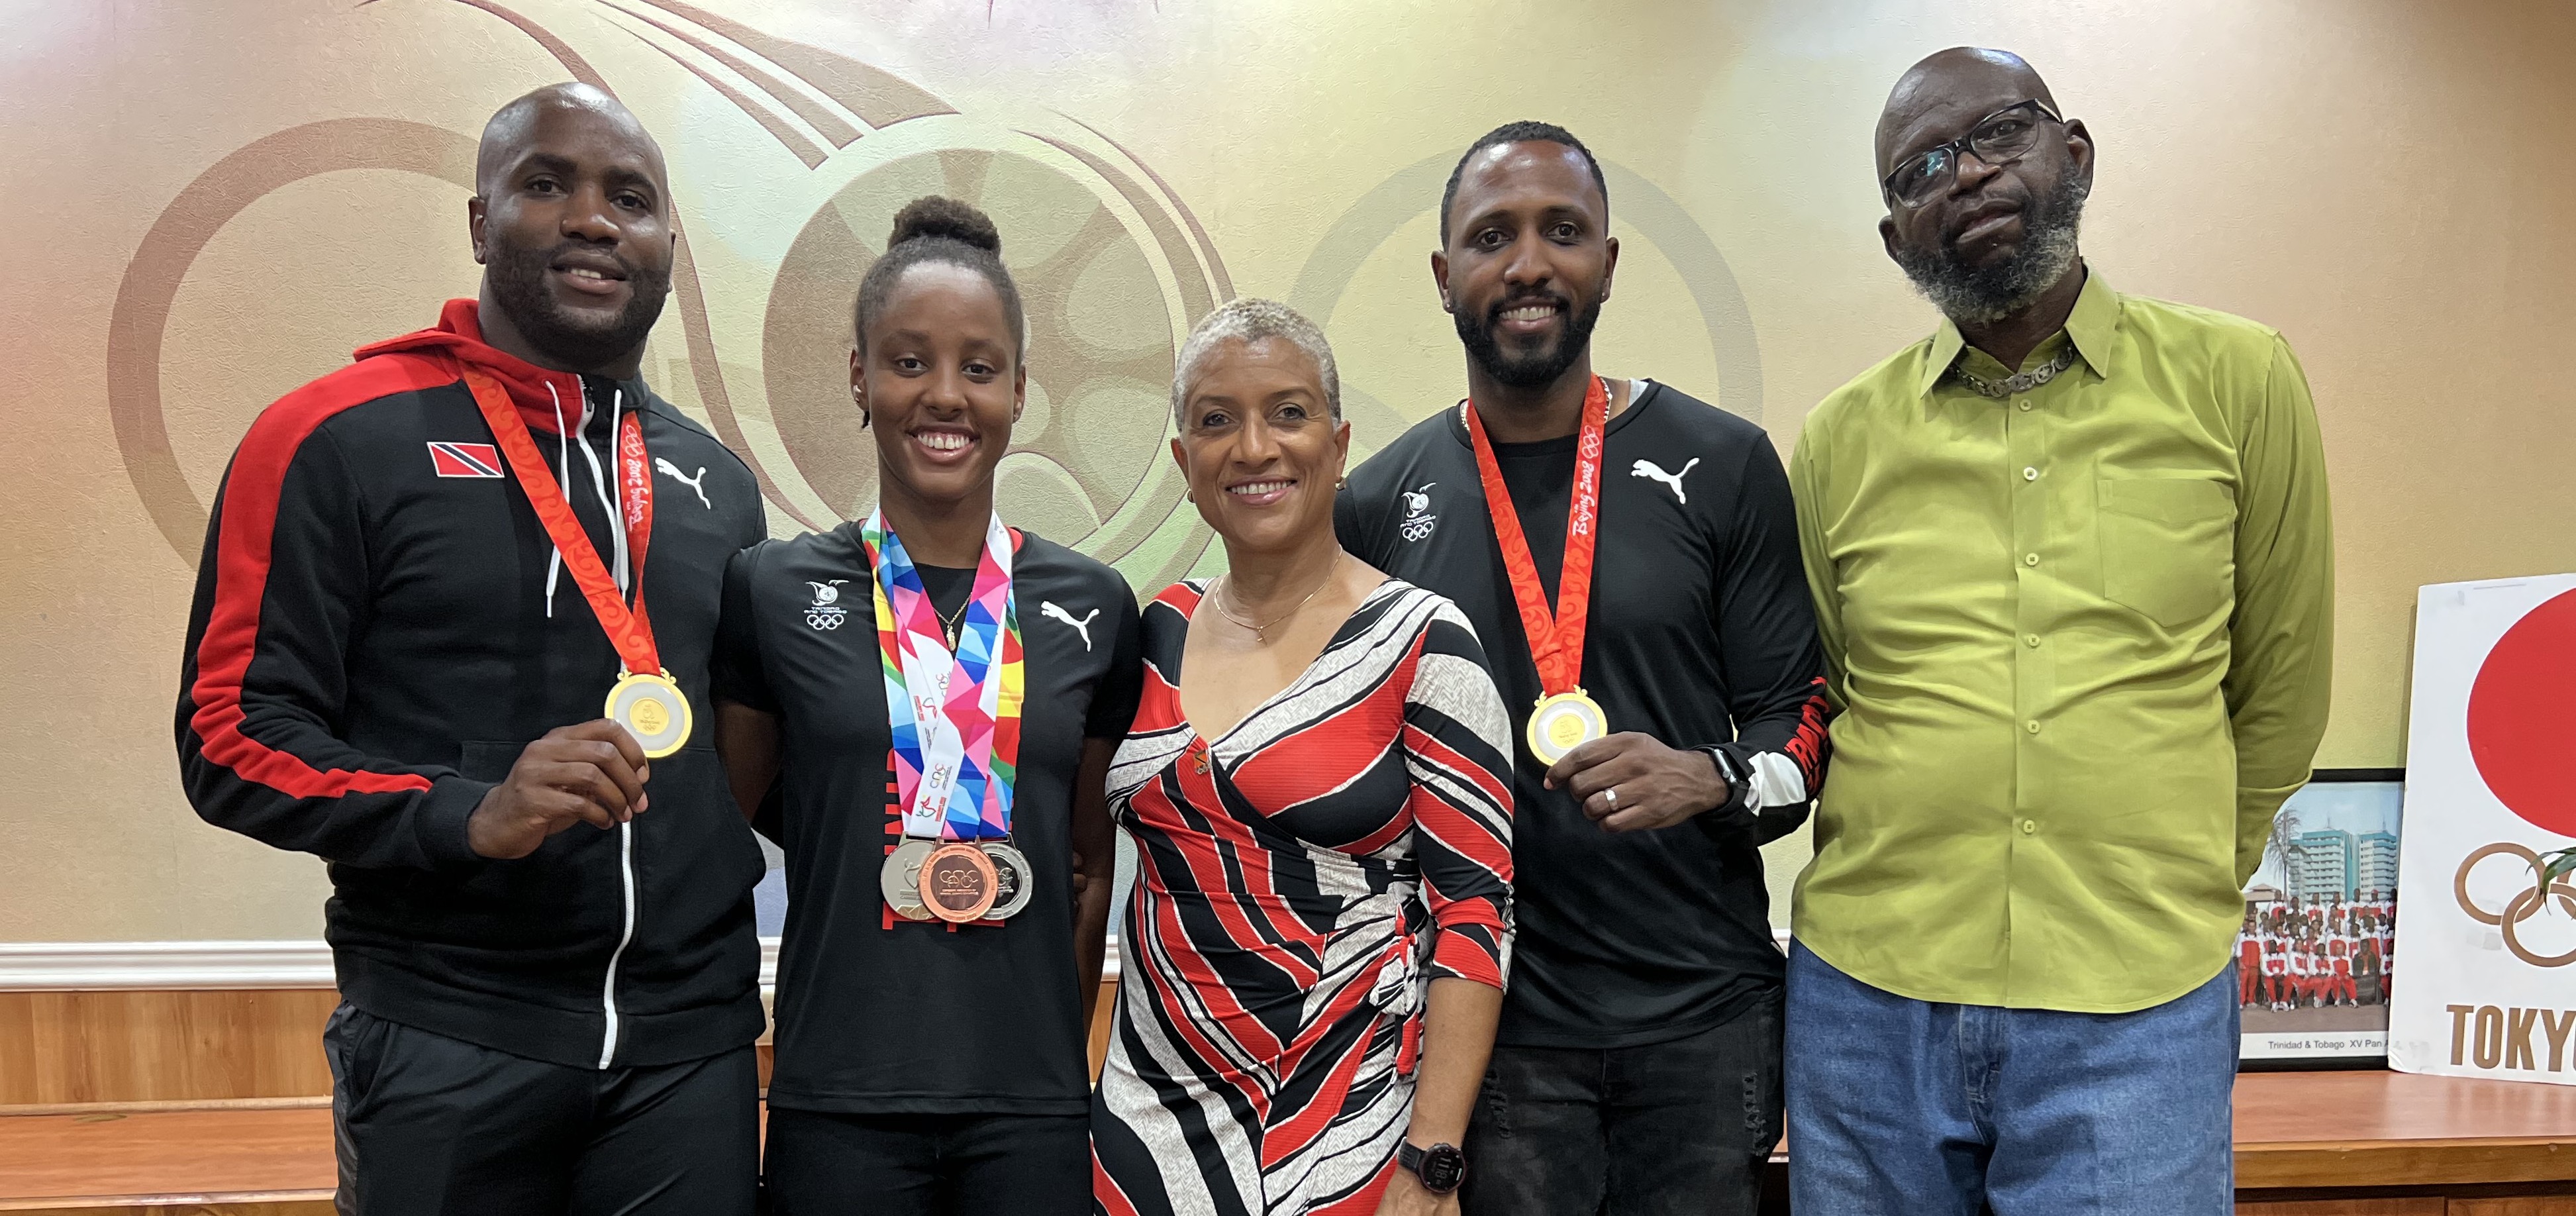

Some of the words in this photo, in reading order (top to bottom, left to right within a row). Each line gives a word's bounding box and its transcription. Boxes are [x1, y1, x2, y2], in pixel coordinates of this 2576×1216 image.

[626, 458, 644, 487] 2008
[1579, 460, 1595, 494] 2008
[626, 487, 649, 532] Beijing
[1572, 493, 1595, 536] Beijing
[2267, 1040, 2303, 1049] Trinidad
[2314, 1040, 2345, 1050] Tobago
[2365, 1039, 2382, 1048] Pan
[2446, 1004, 2576, 1072] TOKY
